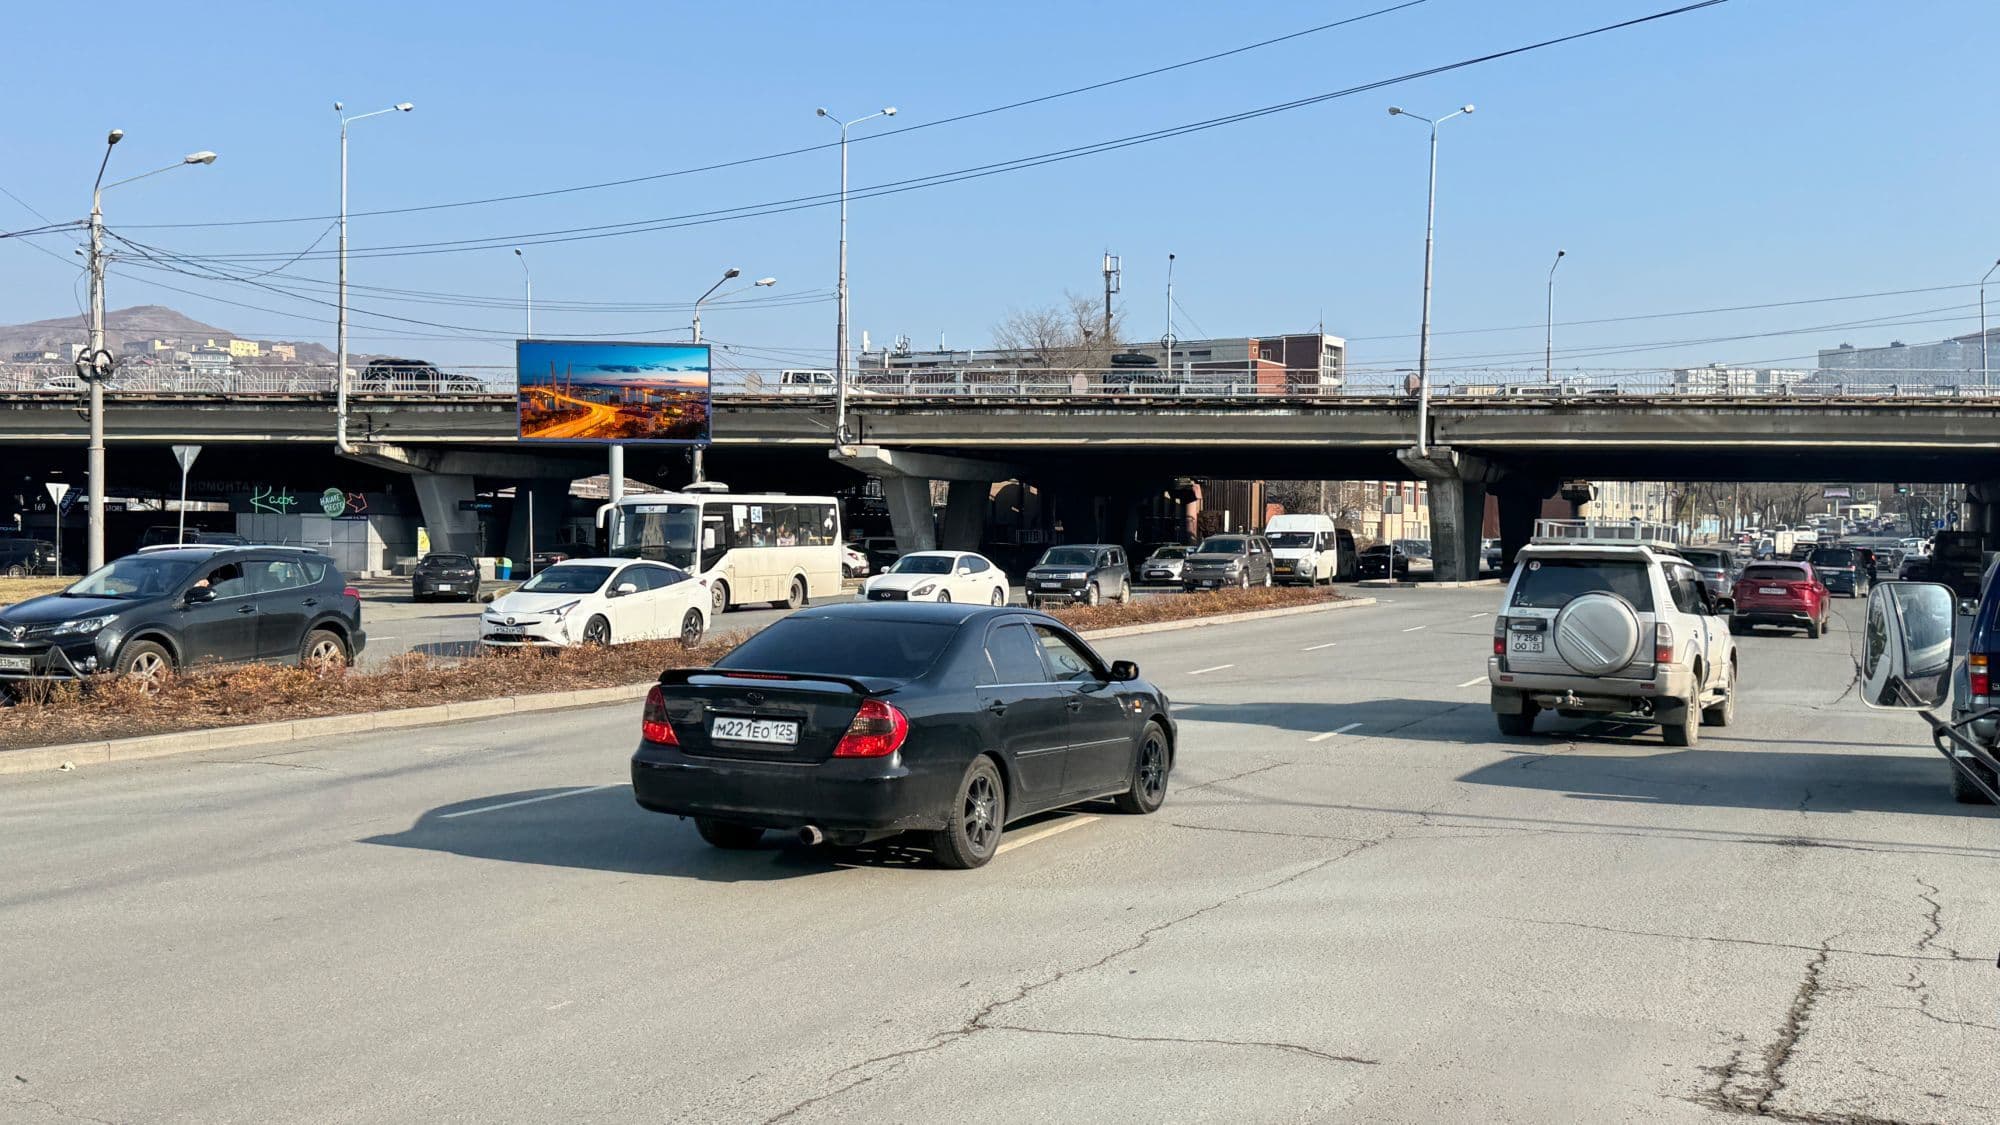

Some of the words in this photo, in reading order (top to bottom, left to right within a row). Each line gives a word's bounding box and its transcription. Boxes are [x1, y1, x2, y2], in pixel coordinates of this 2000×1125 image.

[34, 503, 46, 511] 169
[249, 485, 298, 514] Кафе
[716, 720, 770, 739] М221ЕО
[774, 724, 793, 737] 125
